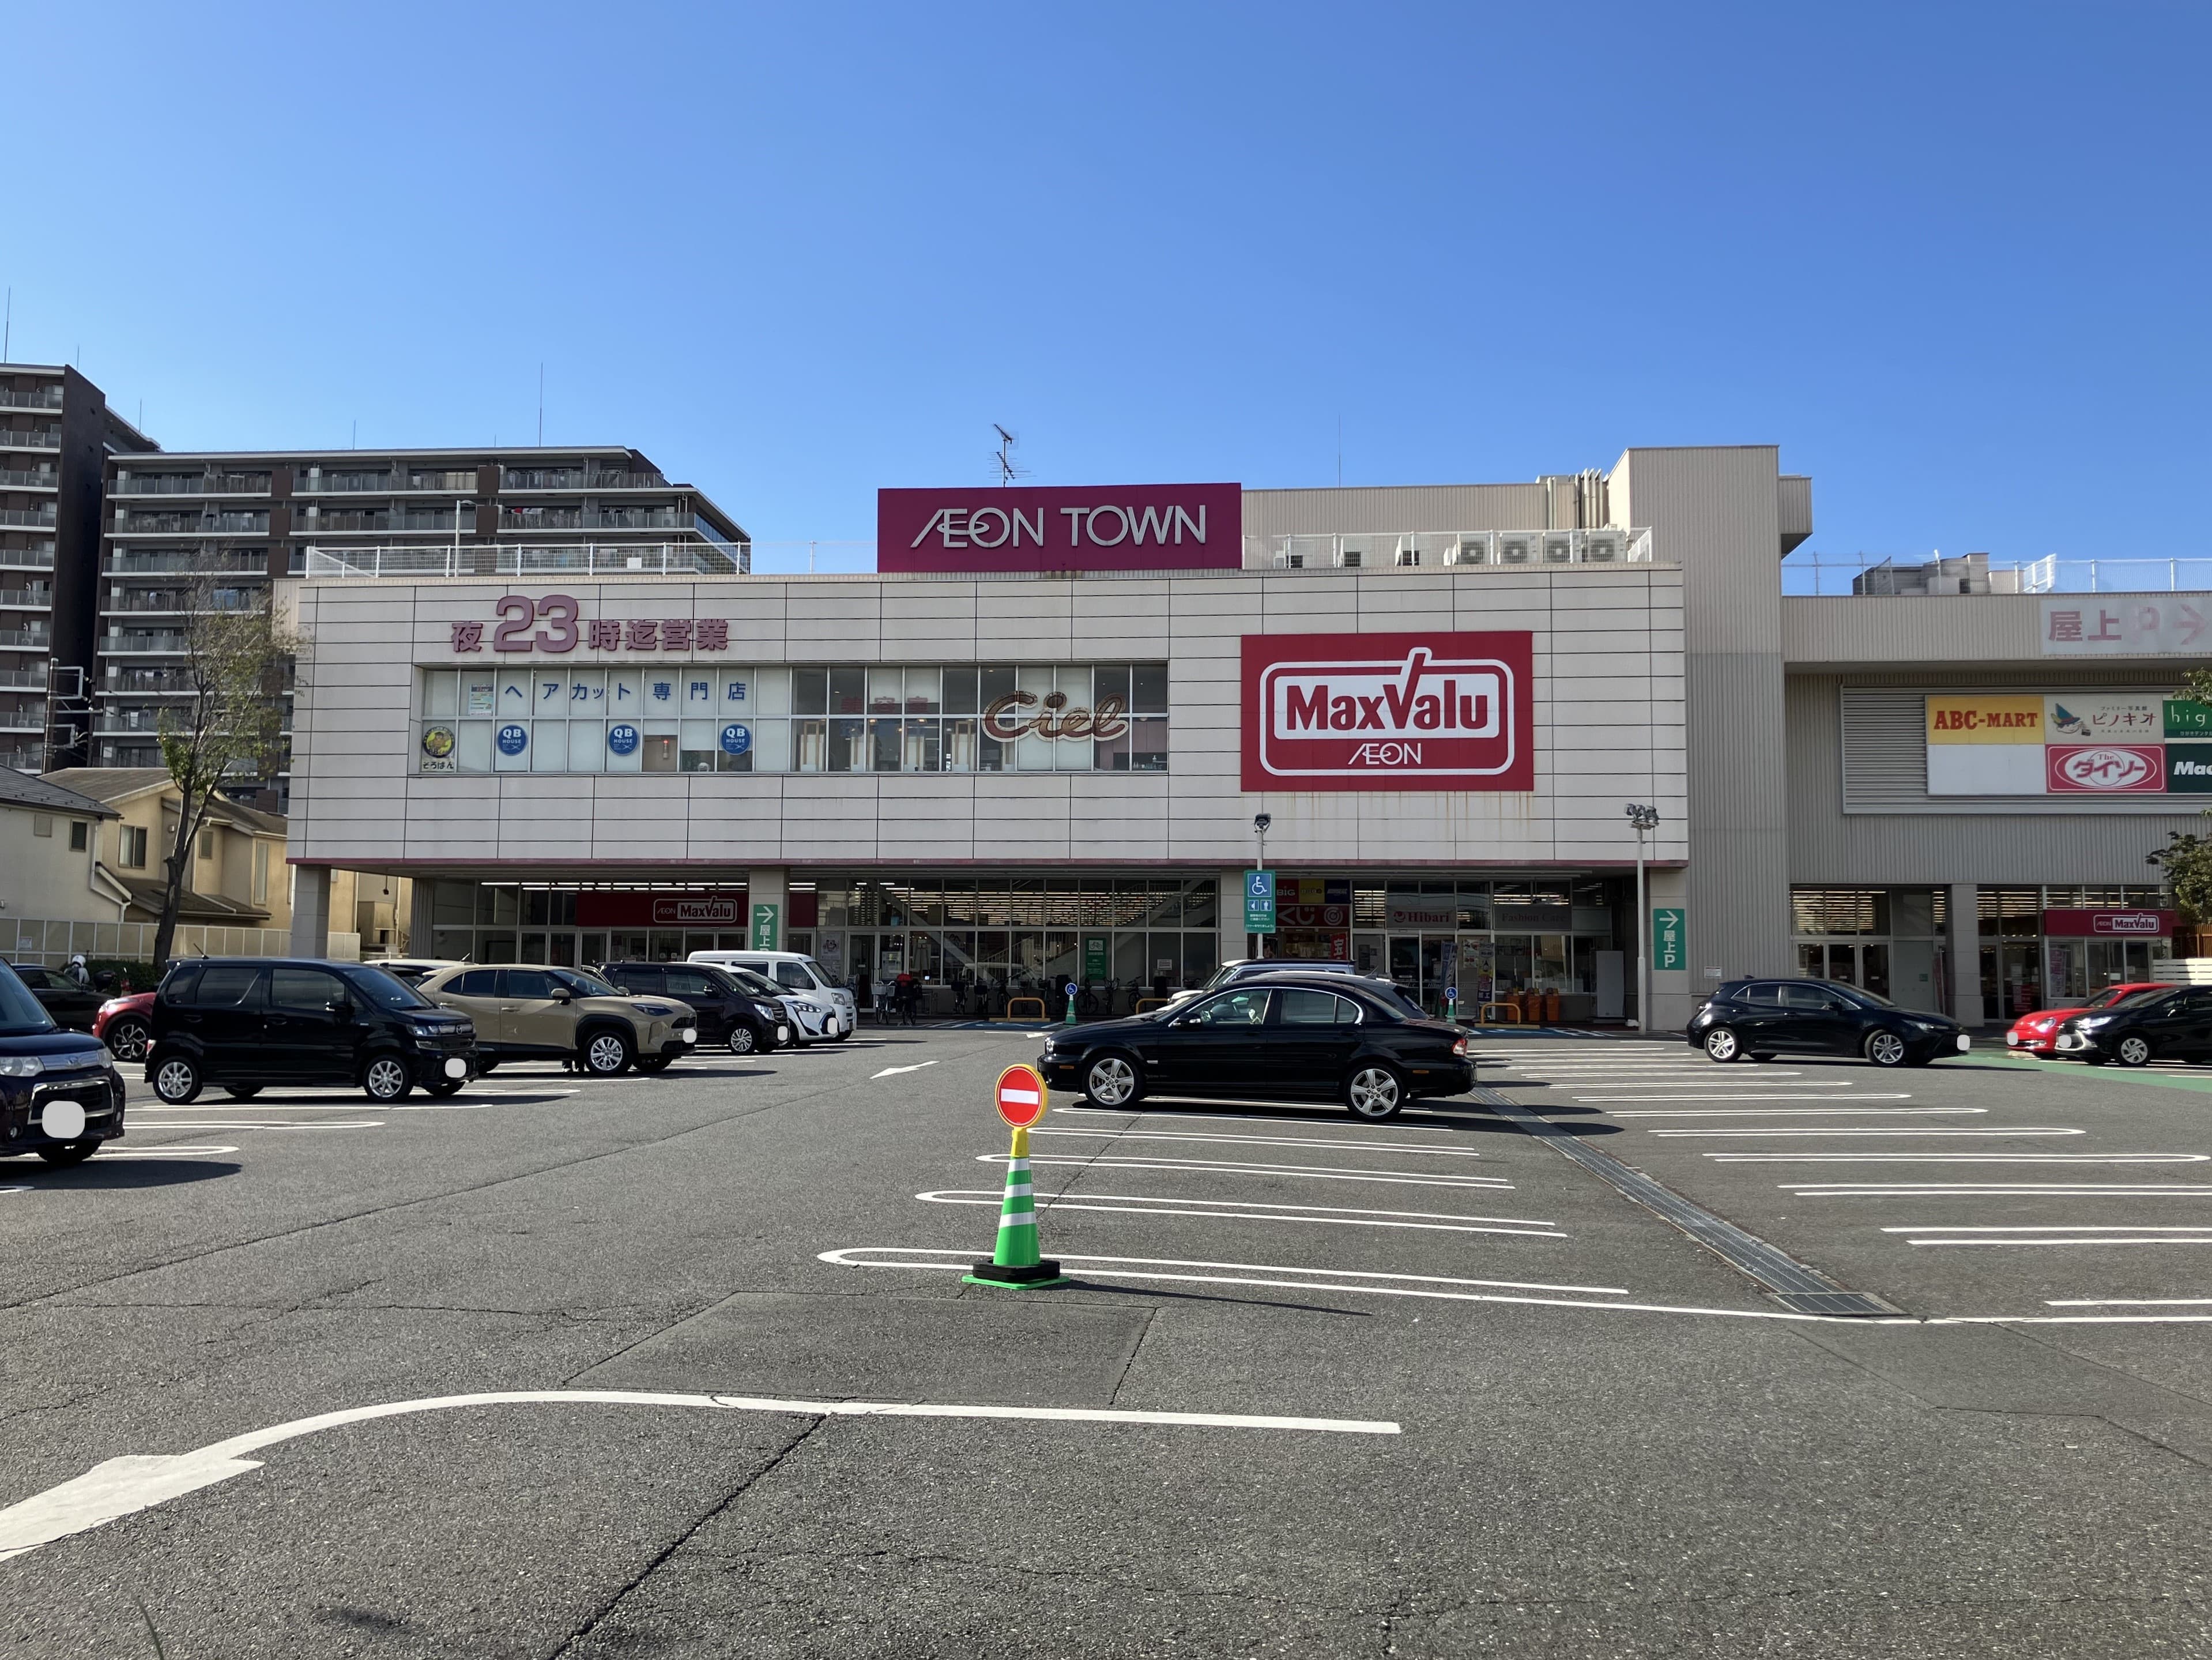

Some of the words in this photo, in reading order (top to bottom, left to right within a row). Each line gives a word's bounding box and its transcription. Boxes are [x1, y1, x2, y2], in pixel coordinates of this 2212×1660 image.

[1060, 505, 1206, 547] TOWN
[451, 594, 729, 653] 夜23時迄営業
[504, 682, 747, 701] ヘアカット専門店
[1286, 653, 1488, 731] MaxValu
[981, 690, 1129, 743] Ciel
[1934, 710, 2038, 731] ABC-MART
[2093, 712, 2156, 727] ピノキオ
[2170, 705, 2206, 727] hig
[503, 729, 522, 739] QB
[614, 728, 632, 738] QB
[726, 728, 745, 737] QB
[423, 761, 454, 770] そろばん
[2072, 758, 2146, 779] ダイソー
[680, 897, 731, 917] MaxValu
[1408, 911, 1449, 923] Hibari
[1502, 913, 1539, 922] Fashion
[2115, 914, 2154, 929] MaxValu
[759, 924, 771, 951] 屋上
[1333, 938, 1344, 959] 宝
[1663, 929, 1676, 968] 屋上P
